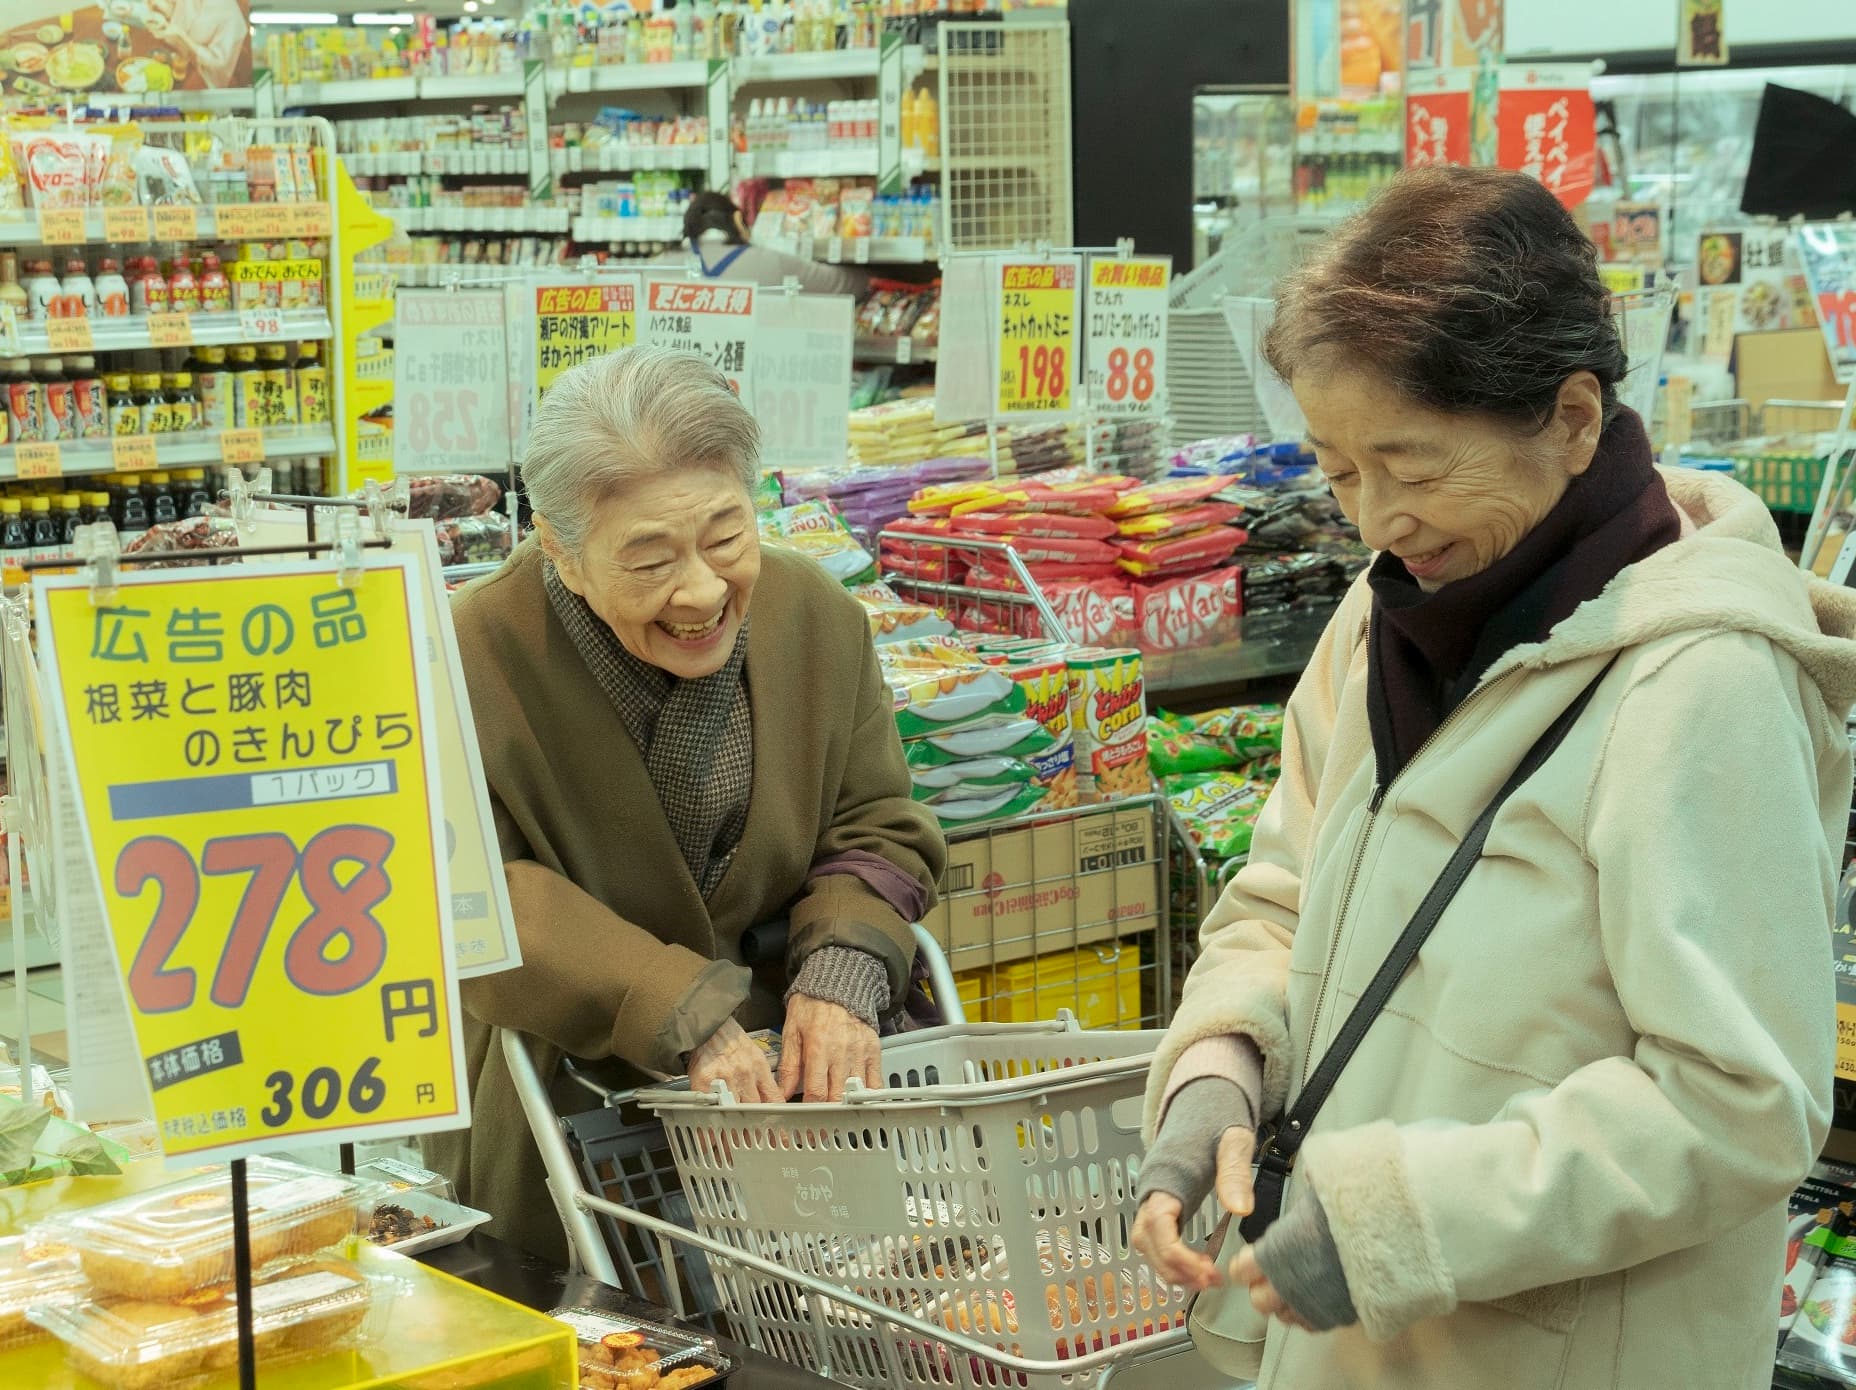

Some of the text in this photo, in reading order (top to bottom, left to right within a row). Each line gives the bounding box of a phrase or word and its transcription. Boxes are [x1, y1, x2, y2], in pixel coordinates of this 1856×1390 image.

[539, 287, 602, 313] 広告の品
[649, 316, 692, 334] ハウス食品
[1003, 293, 1031, 307] ネスレ
[1003, 313, 1070, 339] キットカットミニ
[1019, 345, 1065, 399] 198
[1106, 347, 1155, 402] 88
[90, 588, 367, 664] 広告の品
[1056, 587, 1114, 643] itKat
[1155, 582, 1223, 648] KitKat
[84, 668, 311, 725] 根菜と豚肉
[184, 712, 414, 768] のきんぴら
[114, 824, 396, 1014] 278
[380, 978, 438, 1043] 円
[149, 1038, 225, 1083] 本体価格
[261, 1056, 387, 1128] 306
[415, 1082, 436, 1105] 円
